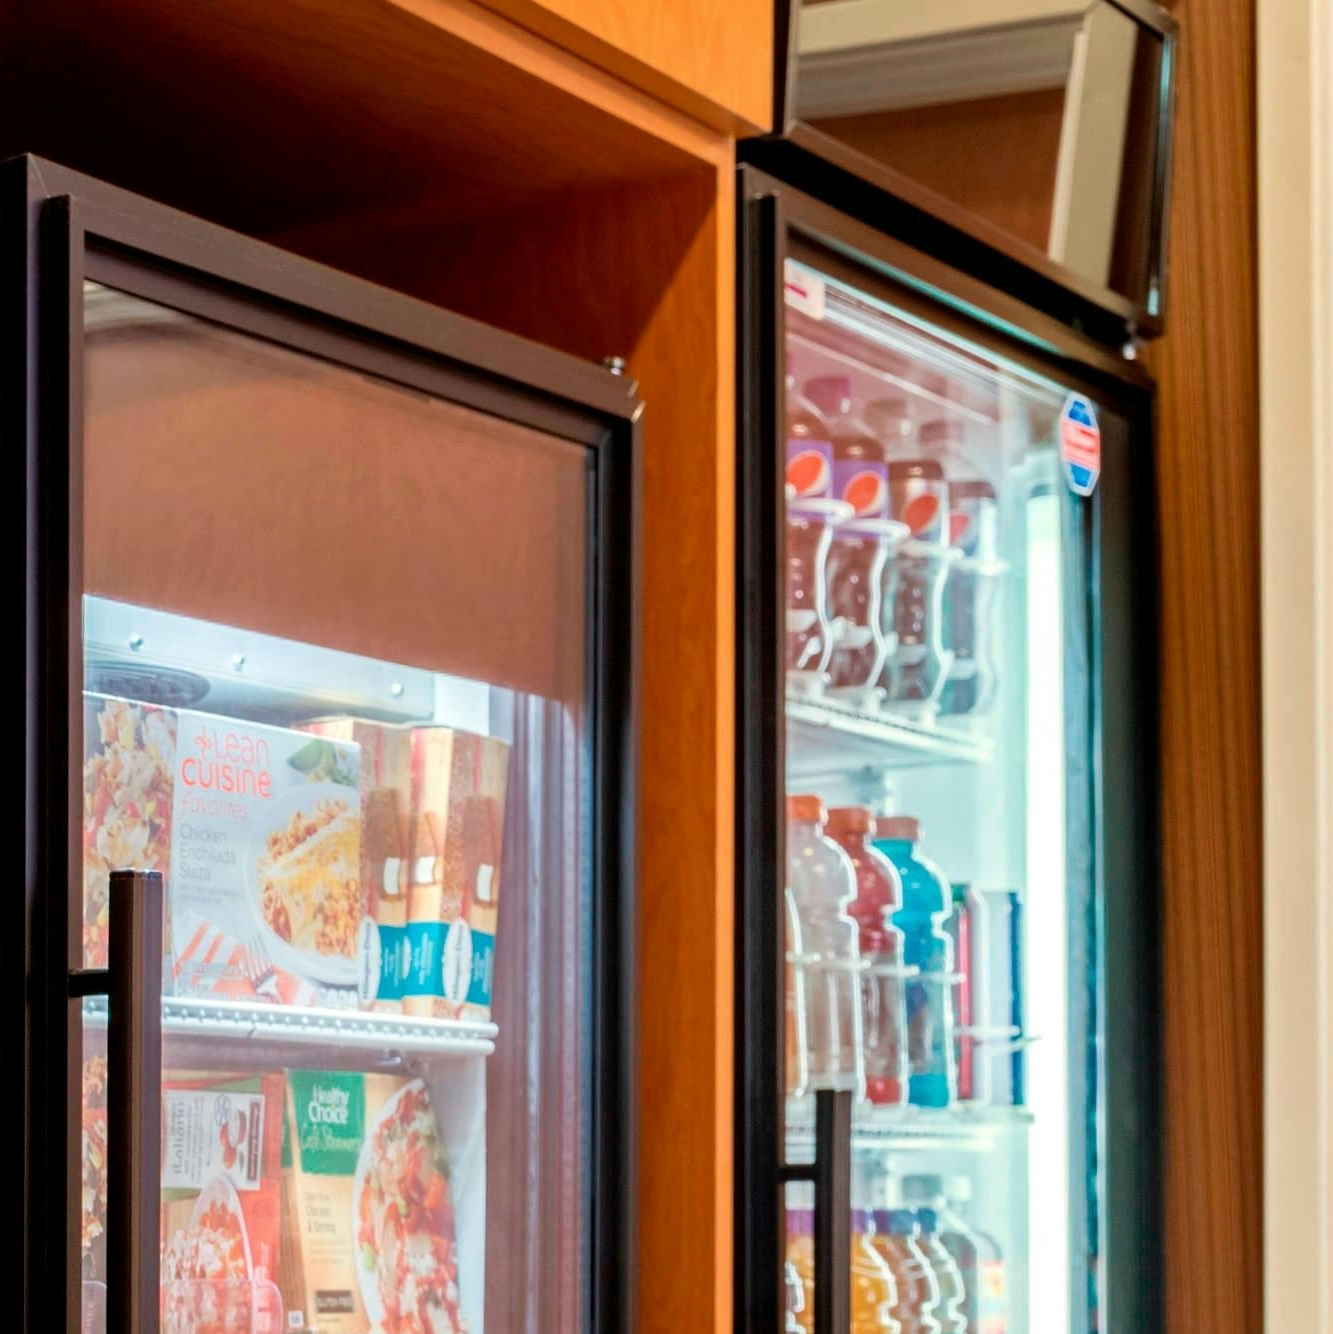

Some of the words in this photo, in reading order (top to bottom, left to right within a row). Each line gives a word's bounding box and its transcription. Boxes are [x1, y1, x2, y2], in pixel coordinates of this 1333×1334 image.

[213, 729, 271, 768] Lean
[181, 823, 228, 844] Chicken
[181, 847, 237, 866] Enchilada
[180, 863, 213, 882] Suiza
[308, 1101, 350, 1125] Choice
